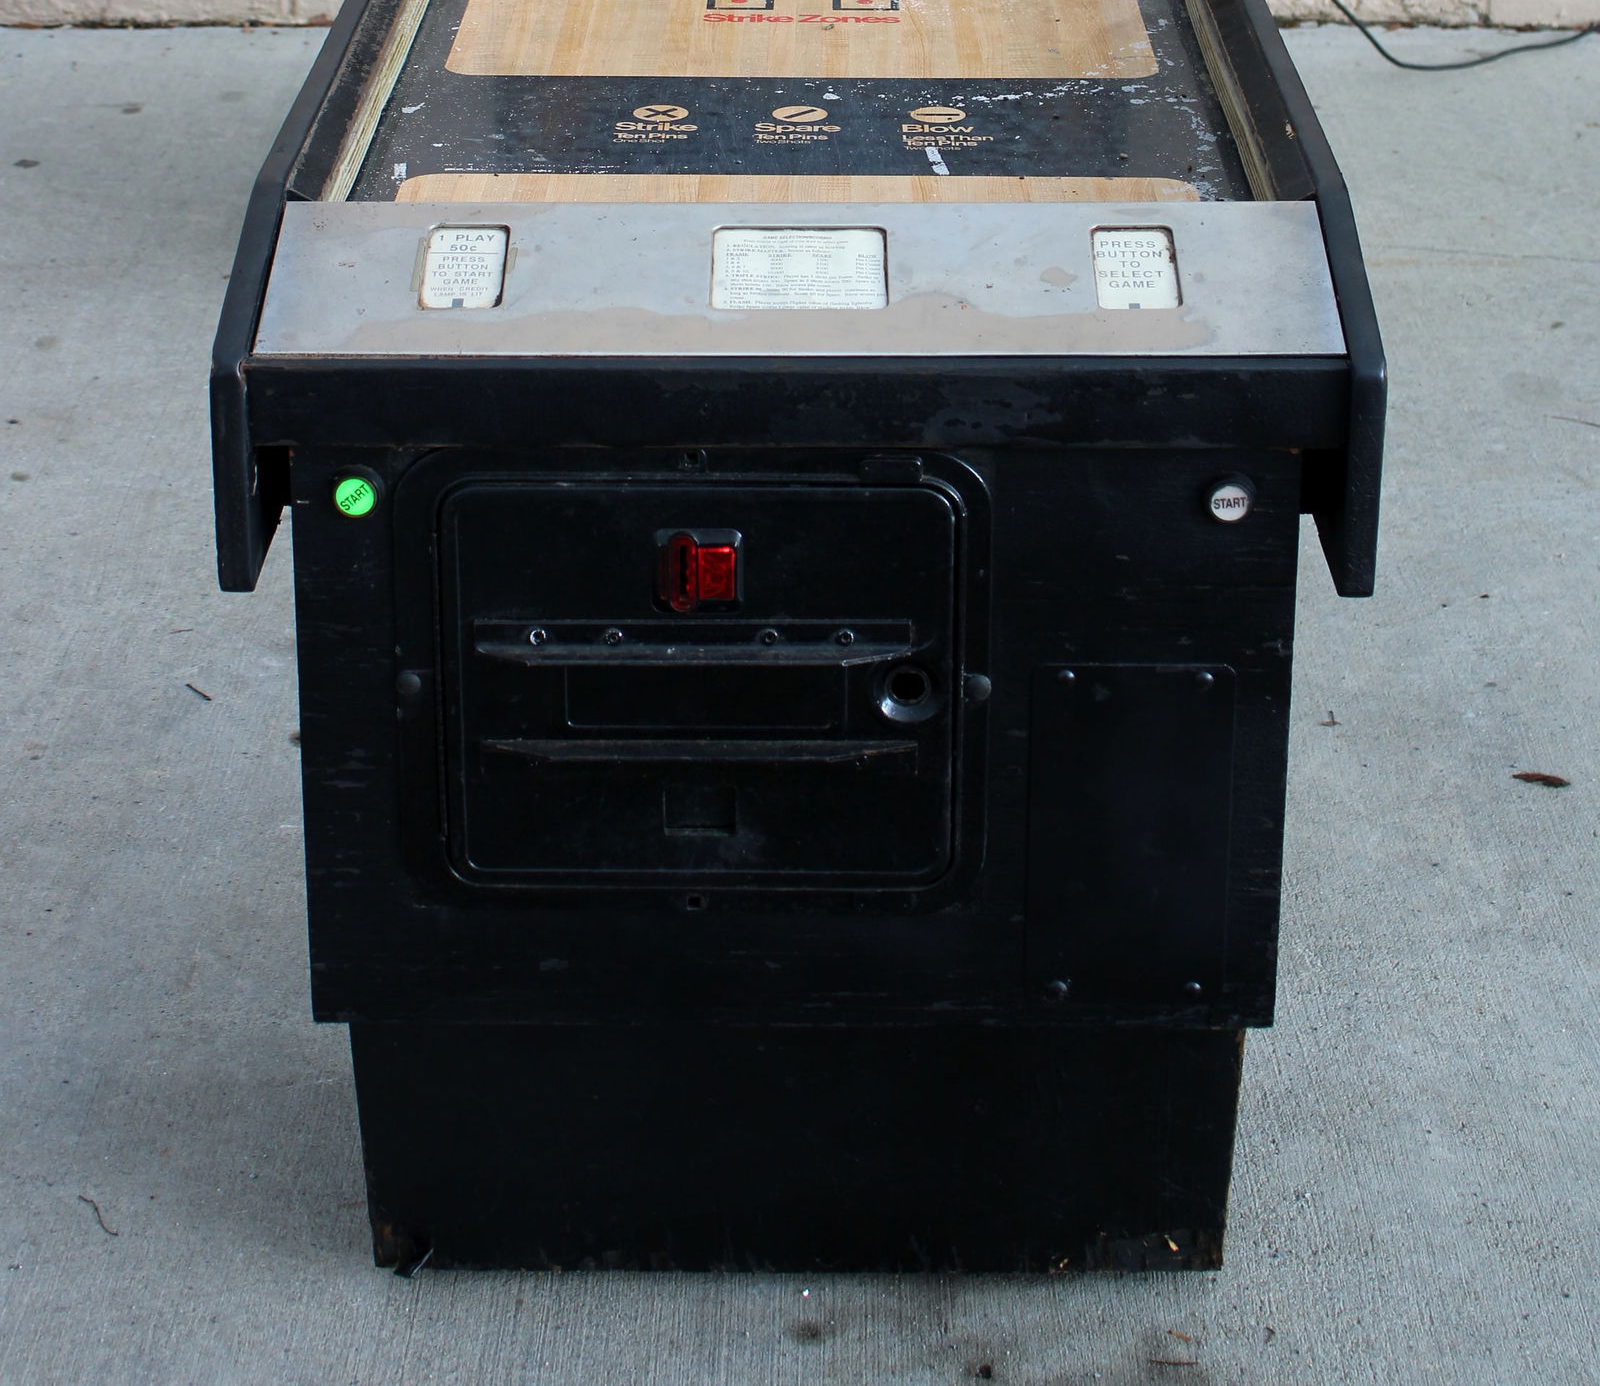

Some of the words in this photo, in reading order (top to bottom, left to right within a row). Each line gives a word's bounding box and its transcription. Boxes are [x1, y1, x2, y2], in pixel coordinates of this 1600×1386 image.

[703, 14, 794, 23] Strike
[798, 15, 900, 24] Zones
[615, 122, 698, 132] Strike
[754, 123, 842, 133] Spare
[902, 124, 974, 133] Blow
[755, 133, 788, 141] Ten
[455, 234, 496, 242] PLAY
[1099, 240, 1157, 248] PRESS
[1096, 250, 1163, 258] BUTTON
[1119, 260, 1141, 268] TO
[1098, 270, 1164, 278] SELECT
[1109, 280, 1156, 288] GAME
[340, 484, 369, 511] START
[1213, 497, 1247, 509] START
